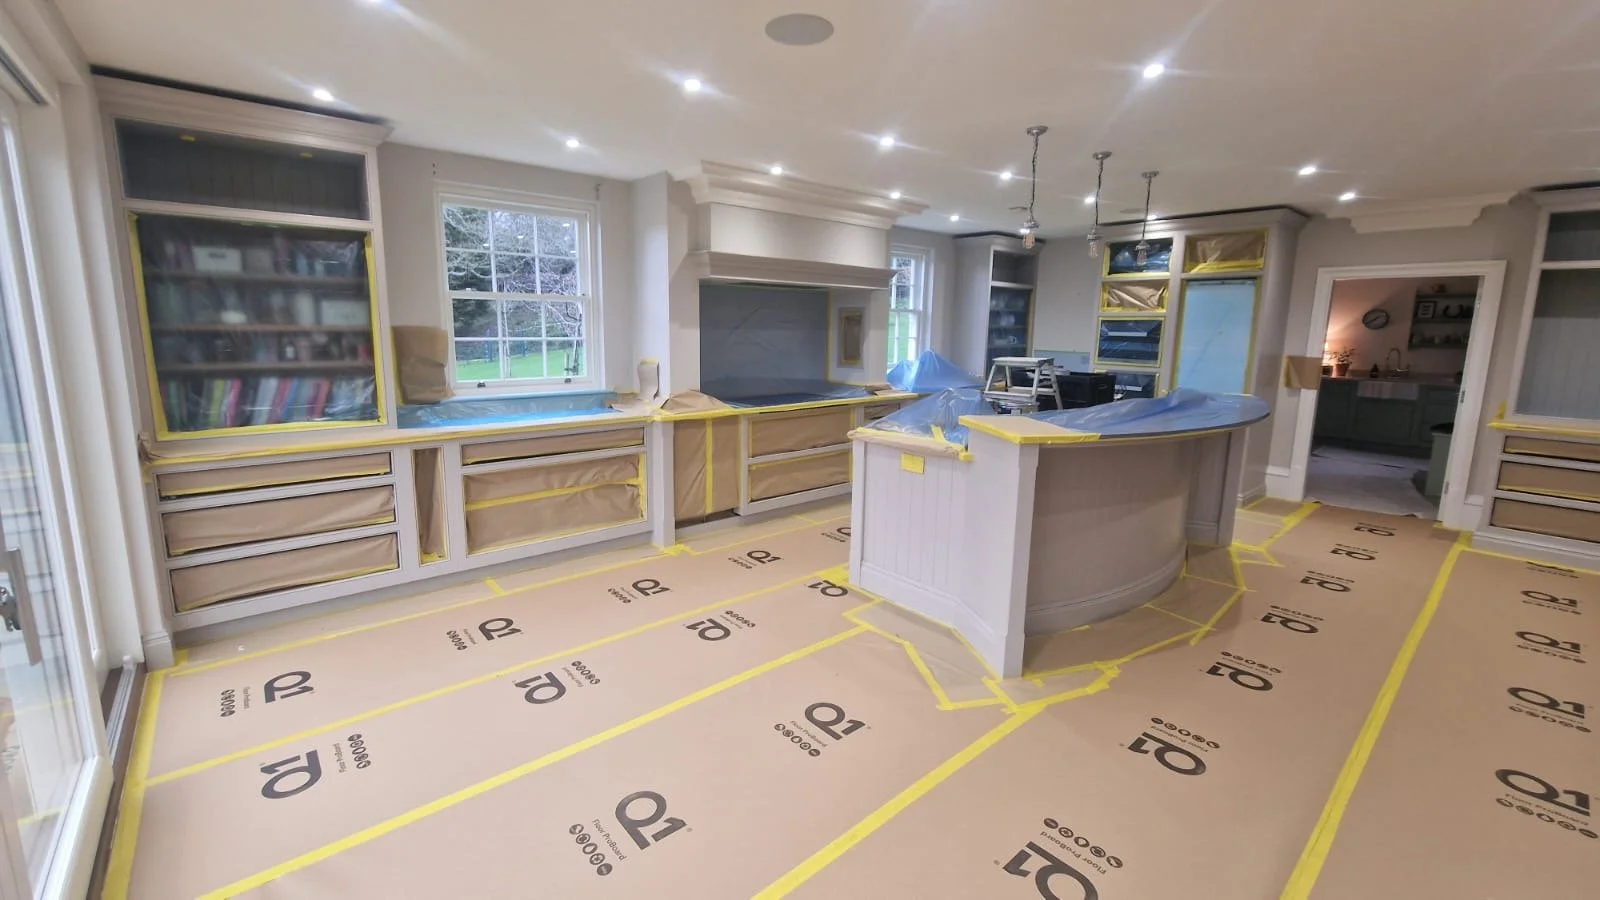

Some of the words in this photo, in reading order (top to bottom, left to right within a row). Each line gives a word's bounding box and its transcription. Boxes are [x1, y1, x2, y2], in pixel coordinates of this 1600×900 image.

[805, 702, 866, 740] Q1
[260, 749, 322, 799] Q1
[1127, 731, 1207, 776] Q1
[1495, 769, 1591, 817] Q1
[615, 790, 688, 850] Q1
[1040, 831, 1082, 859] ProBoard
[1082, 857, 1107, 875] Floor
